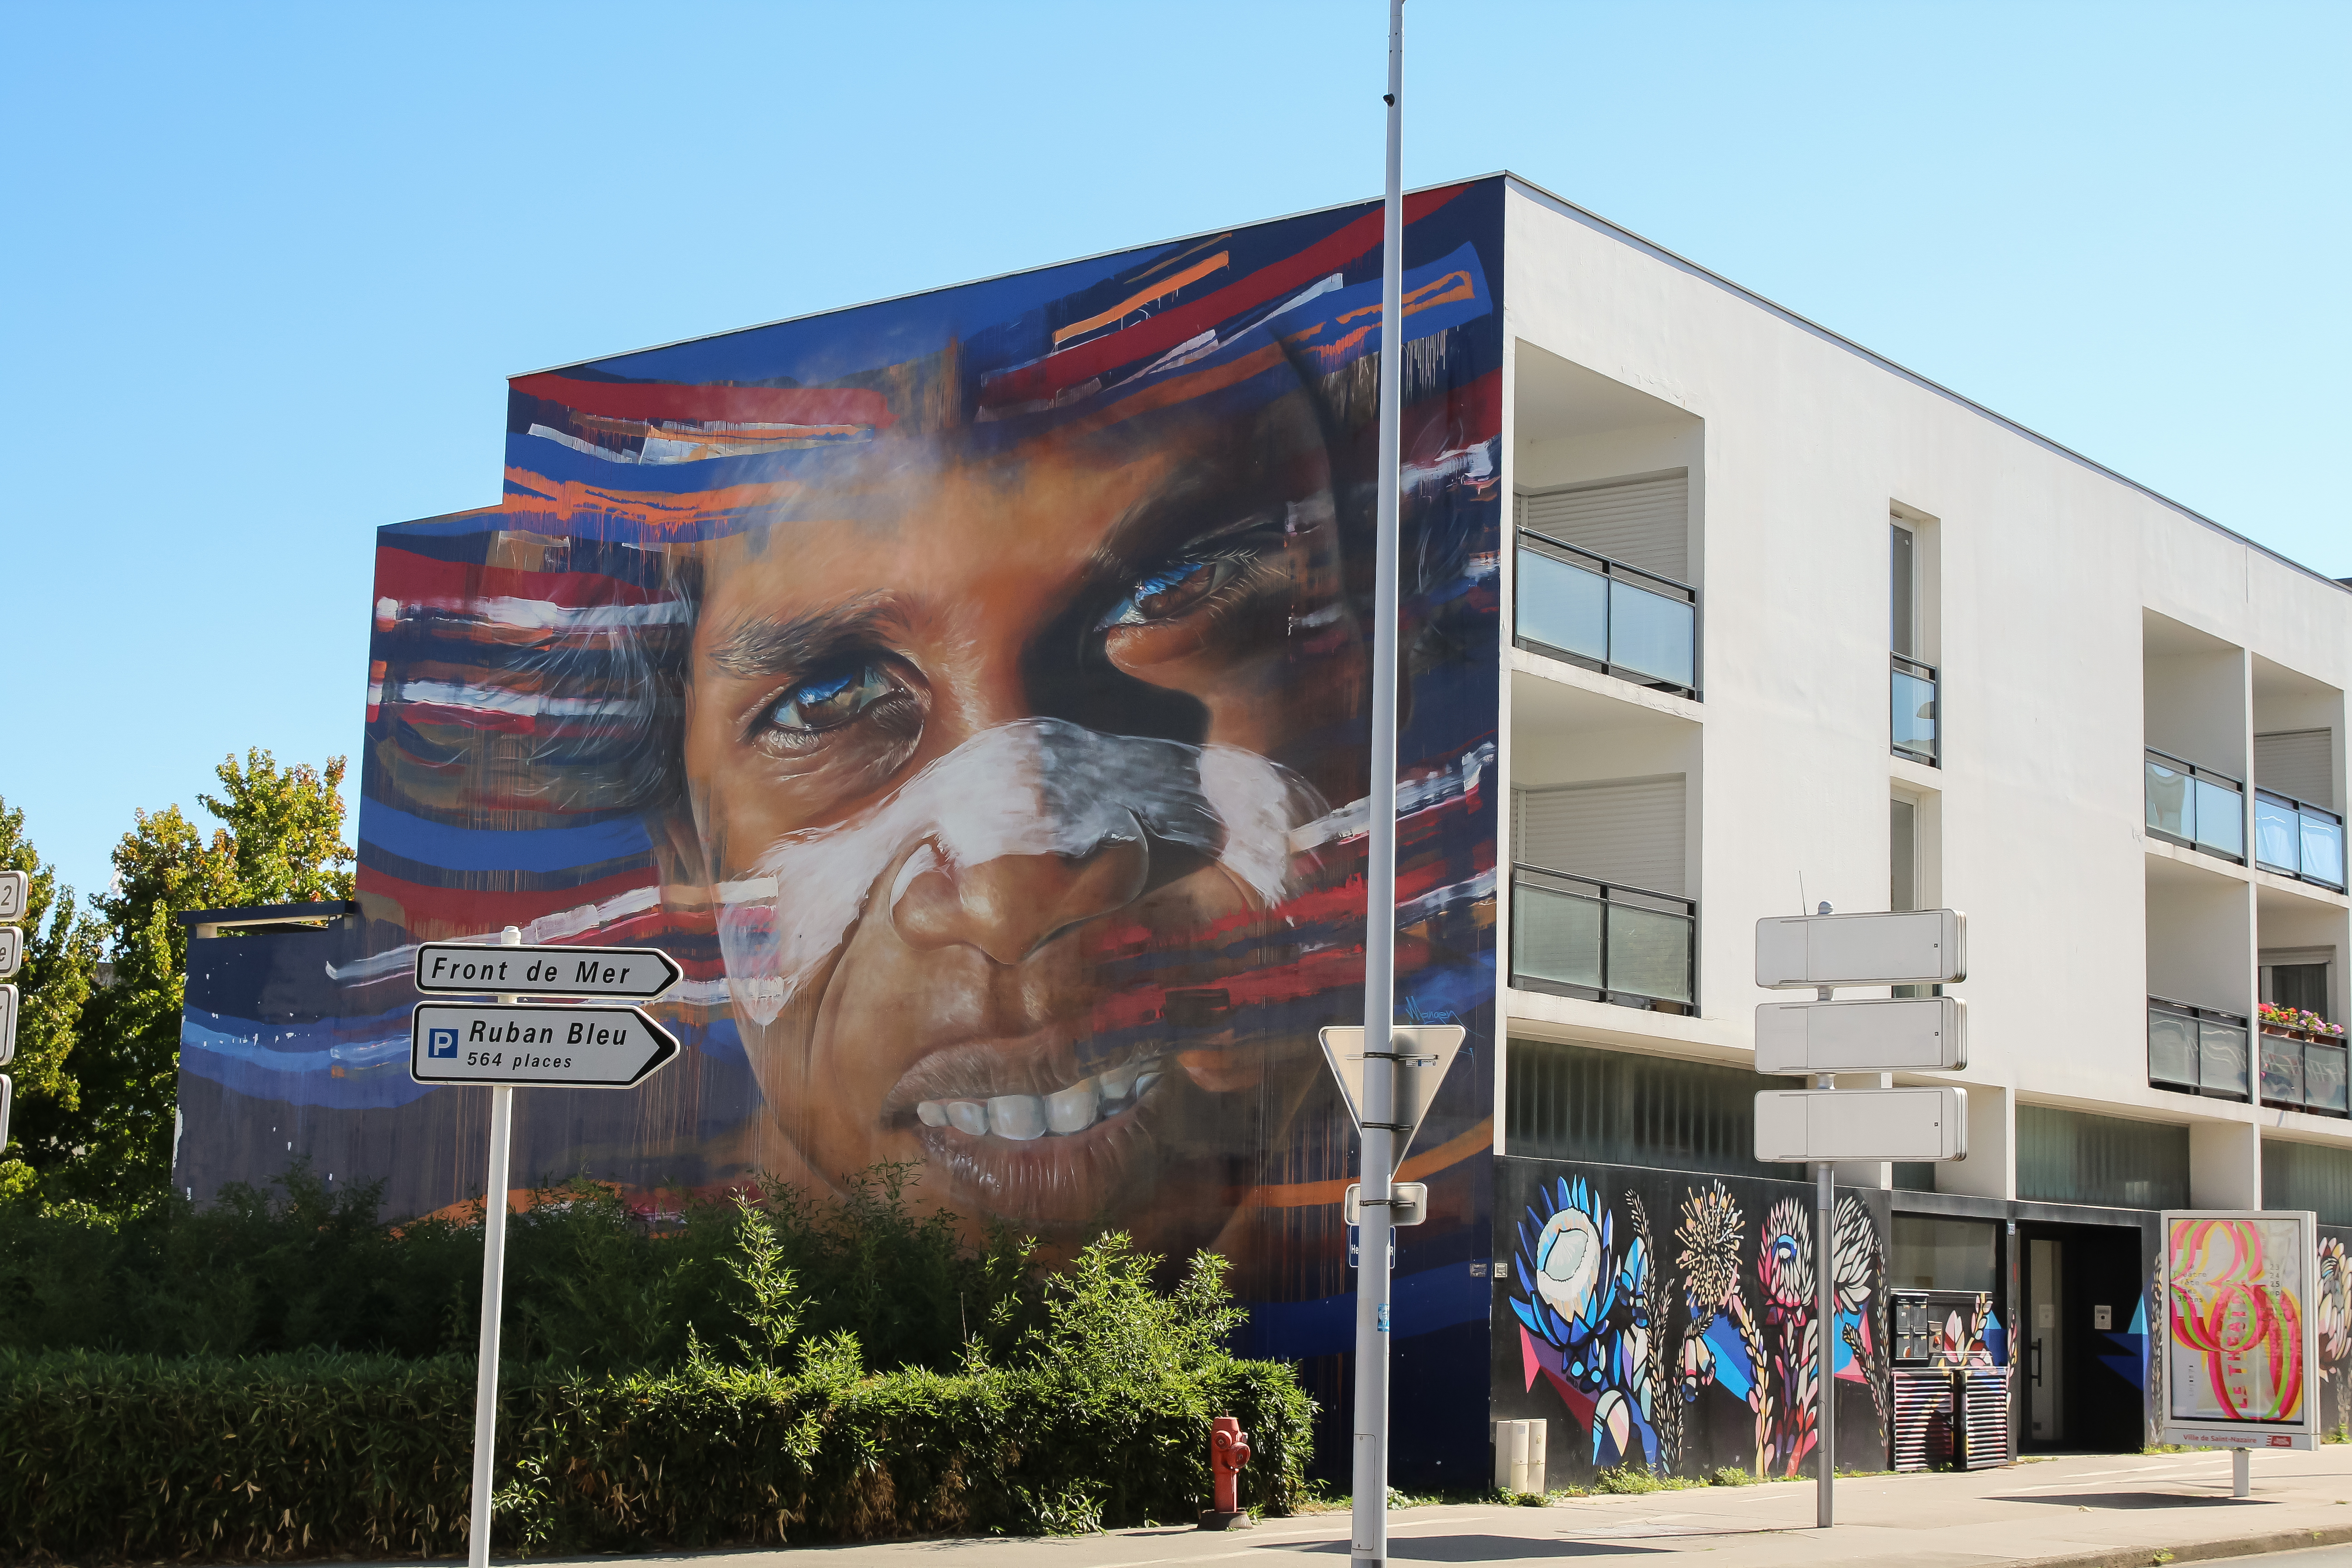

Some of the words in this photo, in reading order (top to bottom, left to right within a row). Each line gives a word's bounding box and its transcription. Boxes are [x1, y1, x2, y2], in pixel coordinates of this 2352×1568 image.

[431, 957, 508, 980] Front
[526, 960, 558, 982] de
[575, 961, 631, 984] Mer
[469, 1020, 554, 1044] Ruban
[567, 1022, 627, 1046] Bleu
[467, 1052, 502, 1067] 564
[512, 1054, 573, 1071] places
